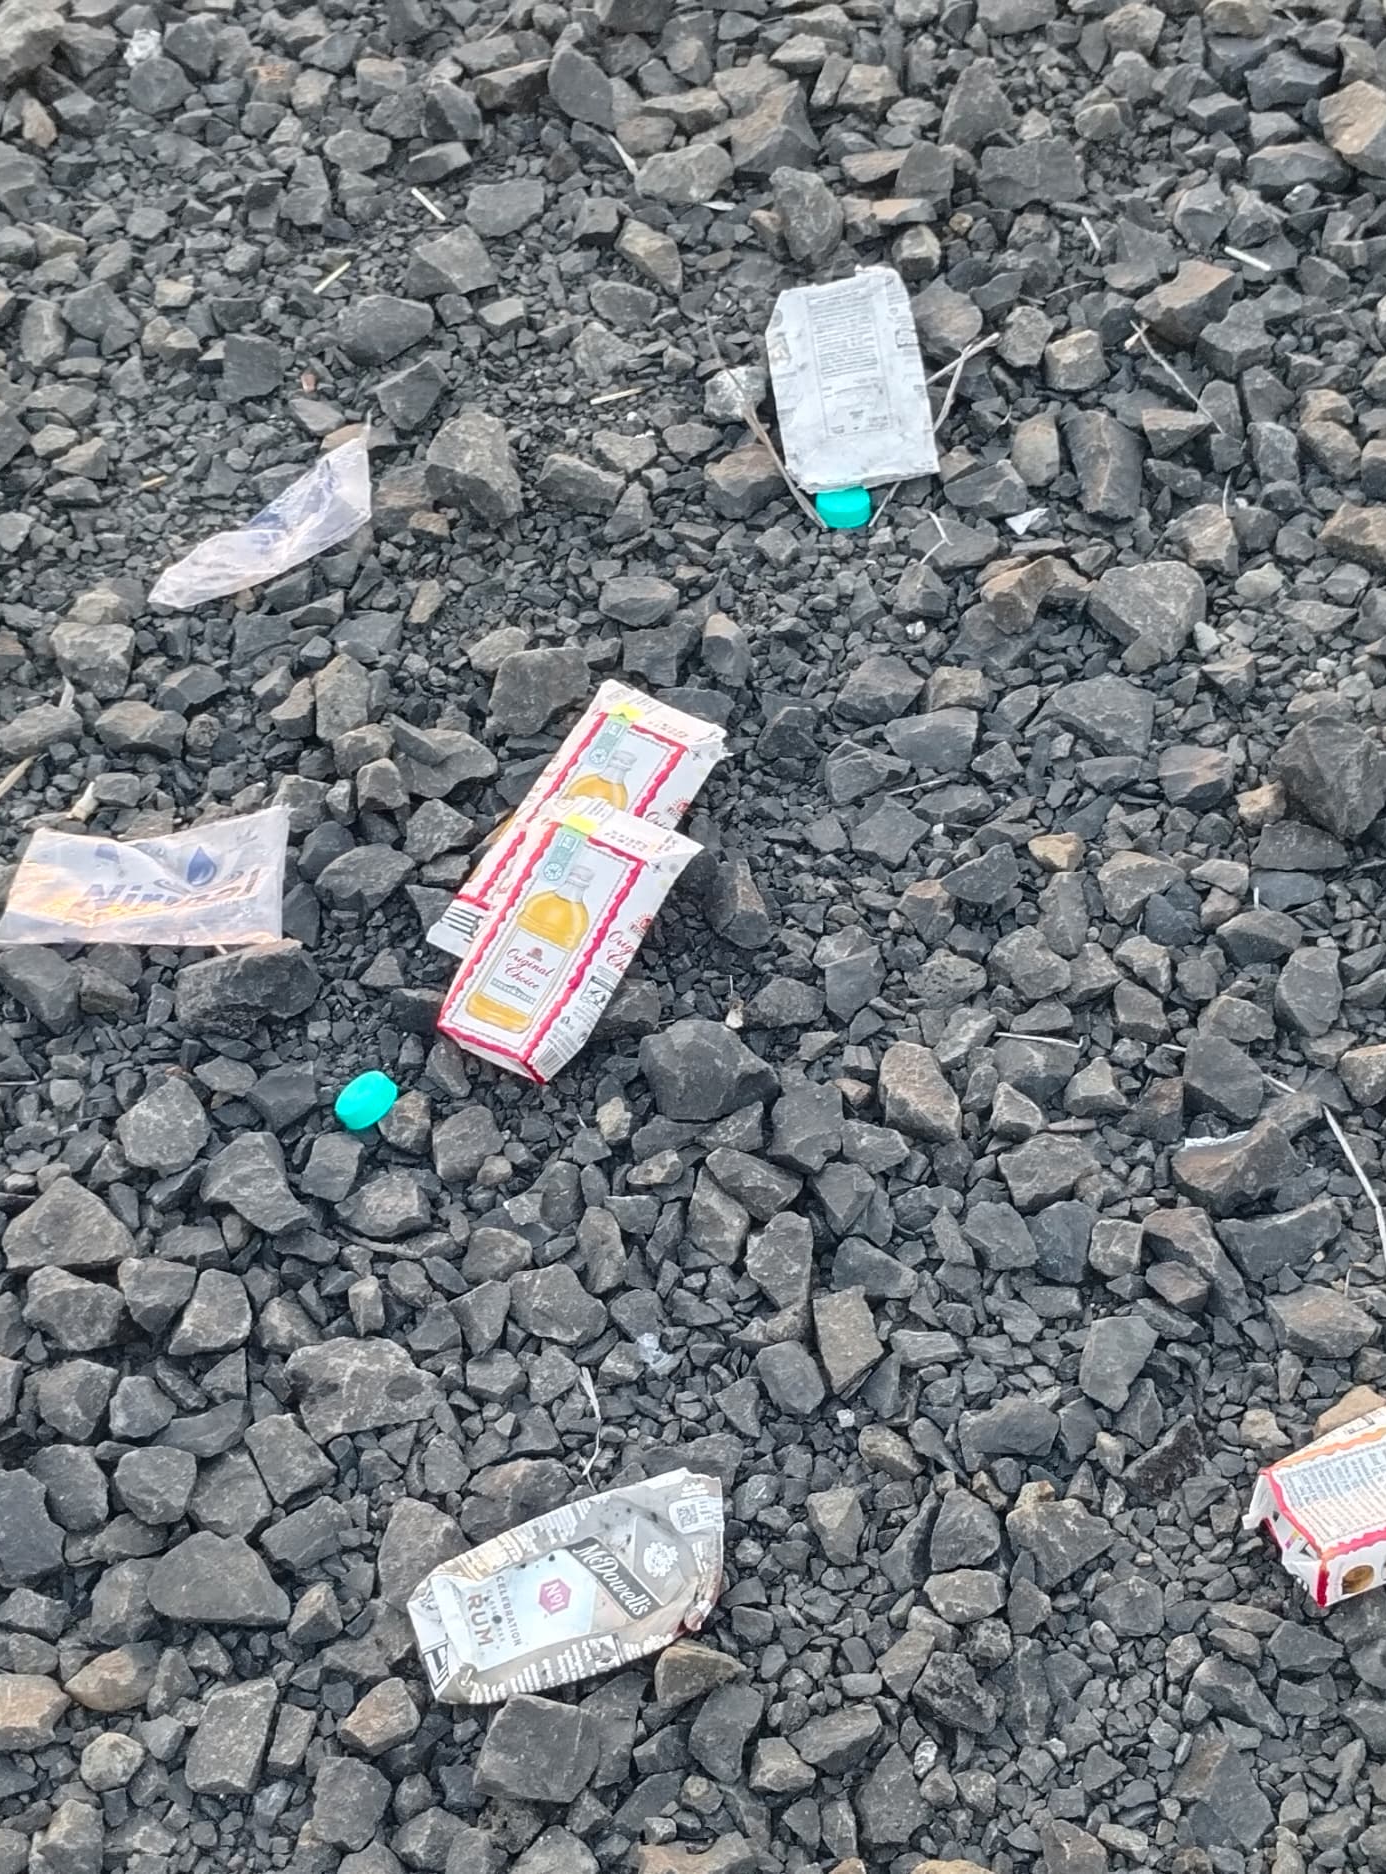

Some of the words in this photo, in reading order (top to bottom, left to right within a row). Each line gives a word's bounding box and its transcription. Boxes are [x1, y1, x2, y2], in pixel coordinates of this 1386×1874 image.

[606, 930, 635, 957] Orig
[606, 949, 627, 972] Ch
[504, 965, 542, 991] Choice
[505, 945, 556, 979] Original
[572, 1543, 652, 1616] McDowell's
[467, 1594, 494, 1647] RUM
[496, 1575, 523, 1647] CELEBRATION
